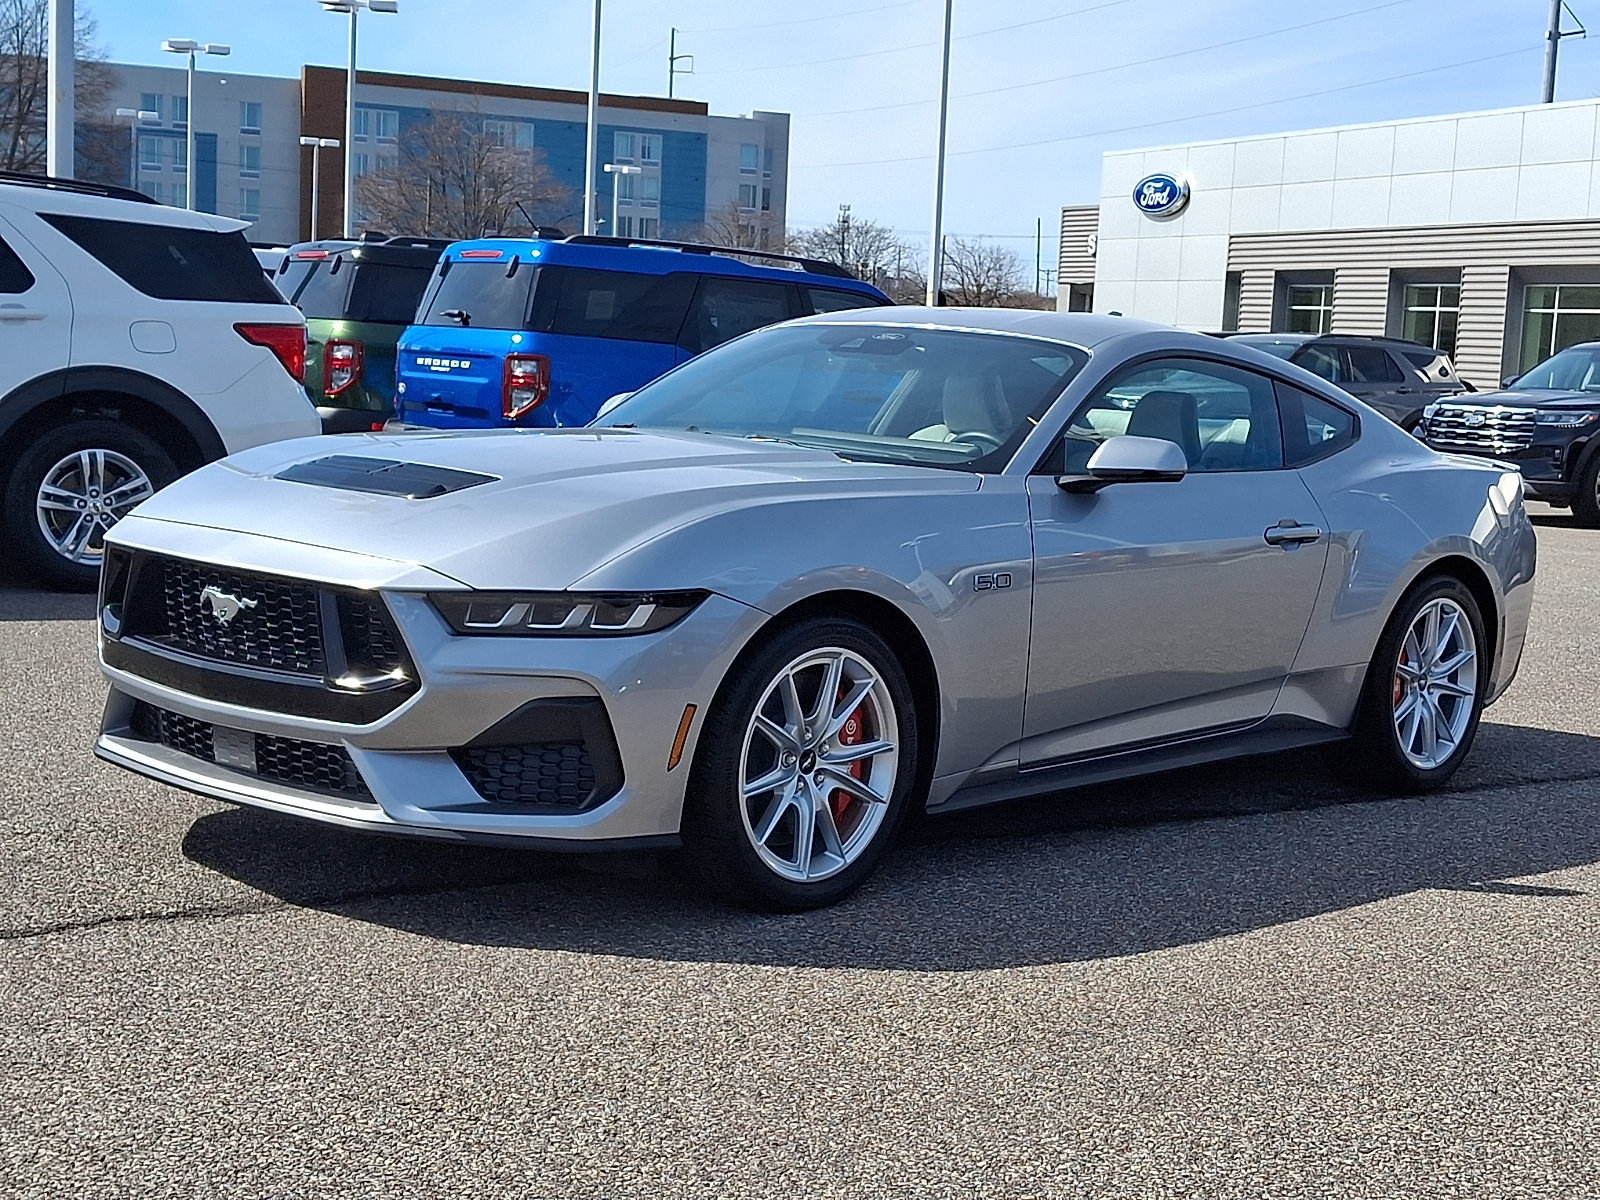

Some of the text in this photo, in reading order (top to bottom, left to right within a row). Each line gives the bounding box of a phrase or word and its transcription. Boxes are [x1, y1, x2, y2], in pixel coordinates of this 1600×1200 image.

[1140, 181, 1170, 206] Ford
[416, 357, 471, 369] BRONCO
[973, 573, 1012, 592] 5.0
